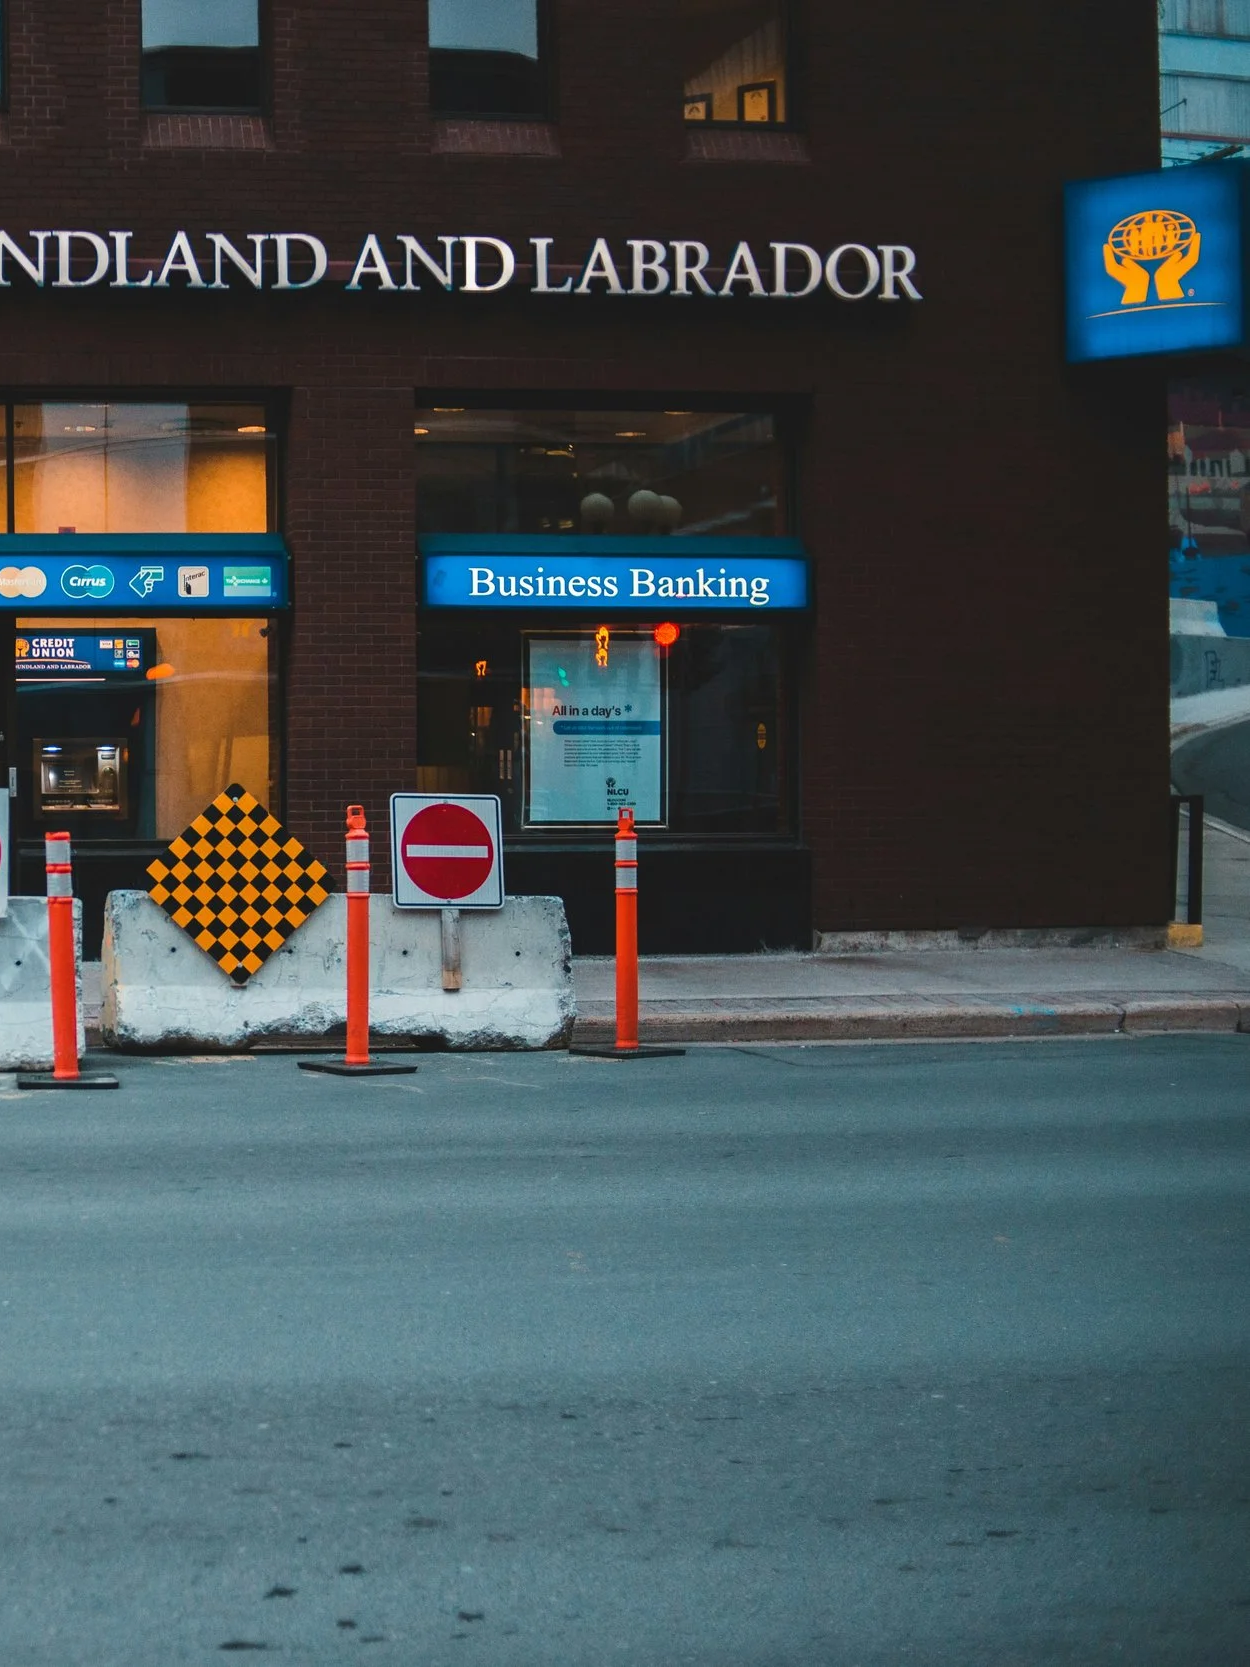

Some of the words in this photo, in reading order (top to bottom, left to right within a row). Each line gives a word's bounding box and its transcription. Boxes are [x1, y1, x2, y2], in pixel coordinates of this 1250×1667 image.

[346, 234, 515, 292] AND
[529, 237, 923, 300] LABRADOR
[69, 576, 106, 587] Cirrus
[183, 571, 206, 588] Interac
[468, 566, 619, 597] Business
[629, 567, 770, 606] Banking
[32, 638, 75, 648] CREDIT
[32, 648, 75, 658] UNION
[552, 705, 567, 716] All
[569, 705, 579, 716] in
[582, 708, 589, 716] a
[591, 705, 621, 718] day's
